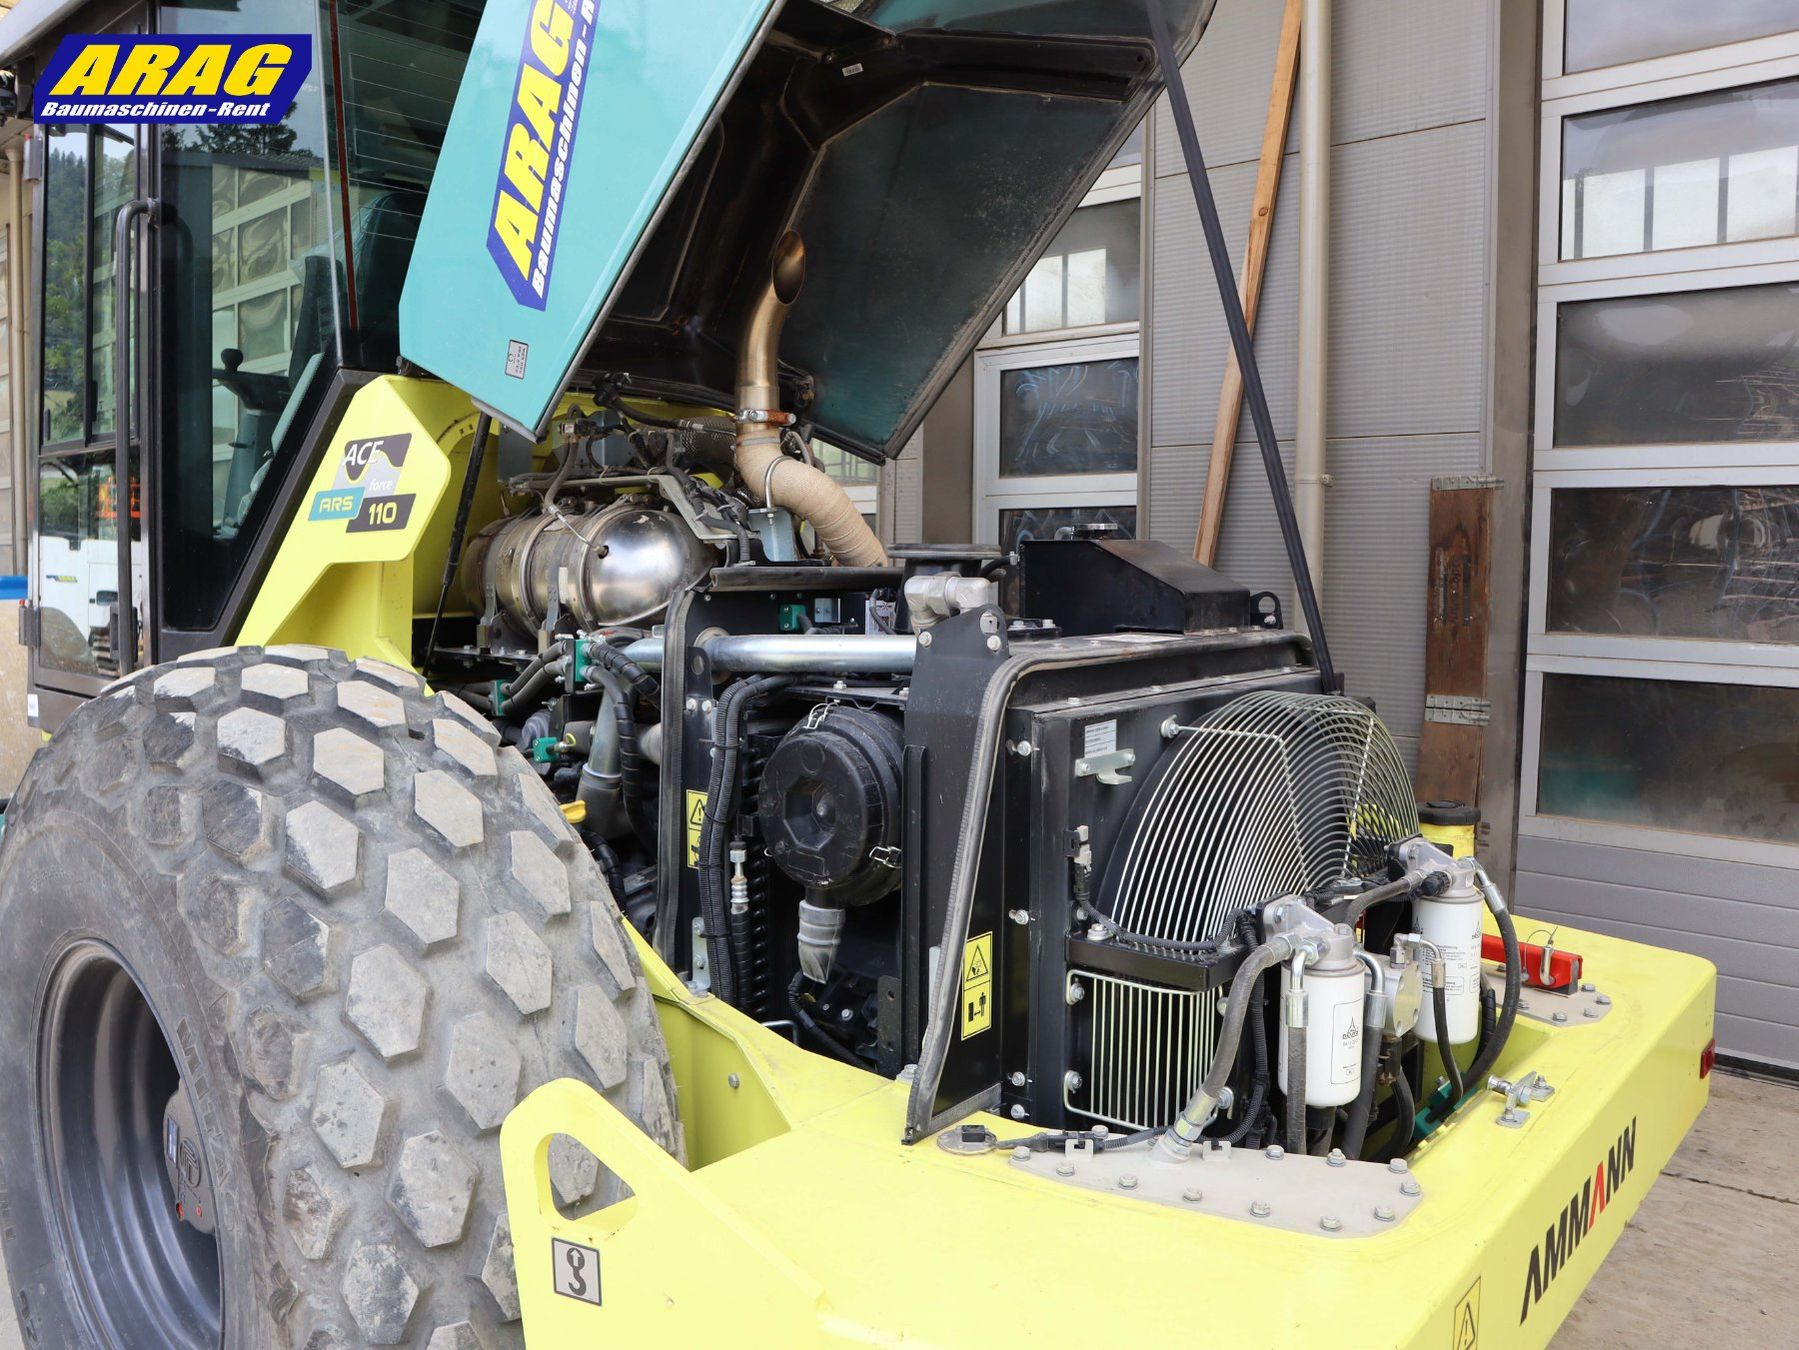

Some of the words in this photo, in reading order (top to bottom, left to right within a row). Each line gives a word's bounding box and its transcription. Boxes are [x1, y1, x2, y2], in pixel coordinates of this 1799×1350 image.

[494, 0, 575, 282] ARAG
[342, 440, 384, 466] ACE
[368, 478, 393, 492] force
[319, 495, 354, 513] ARS
[368, 501, 398, 525] 110
[1520, 1115, 1638, 1327] AMMANN
